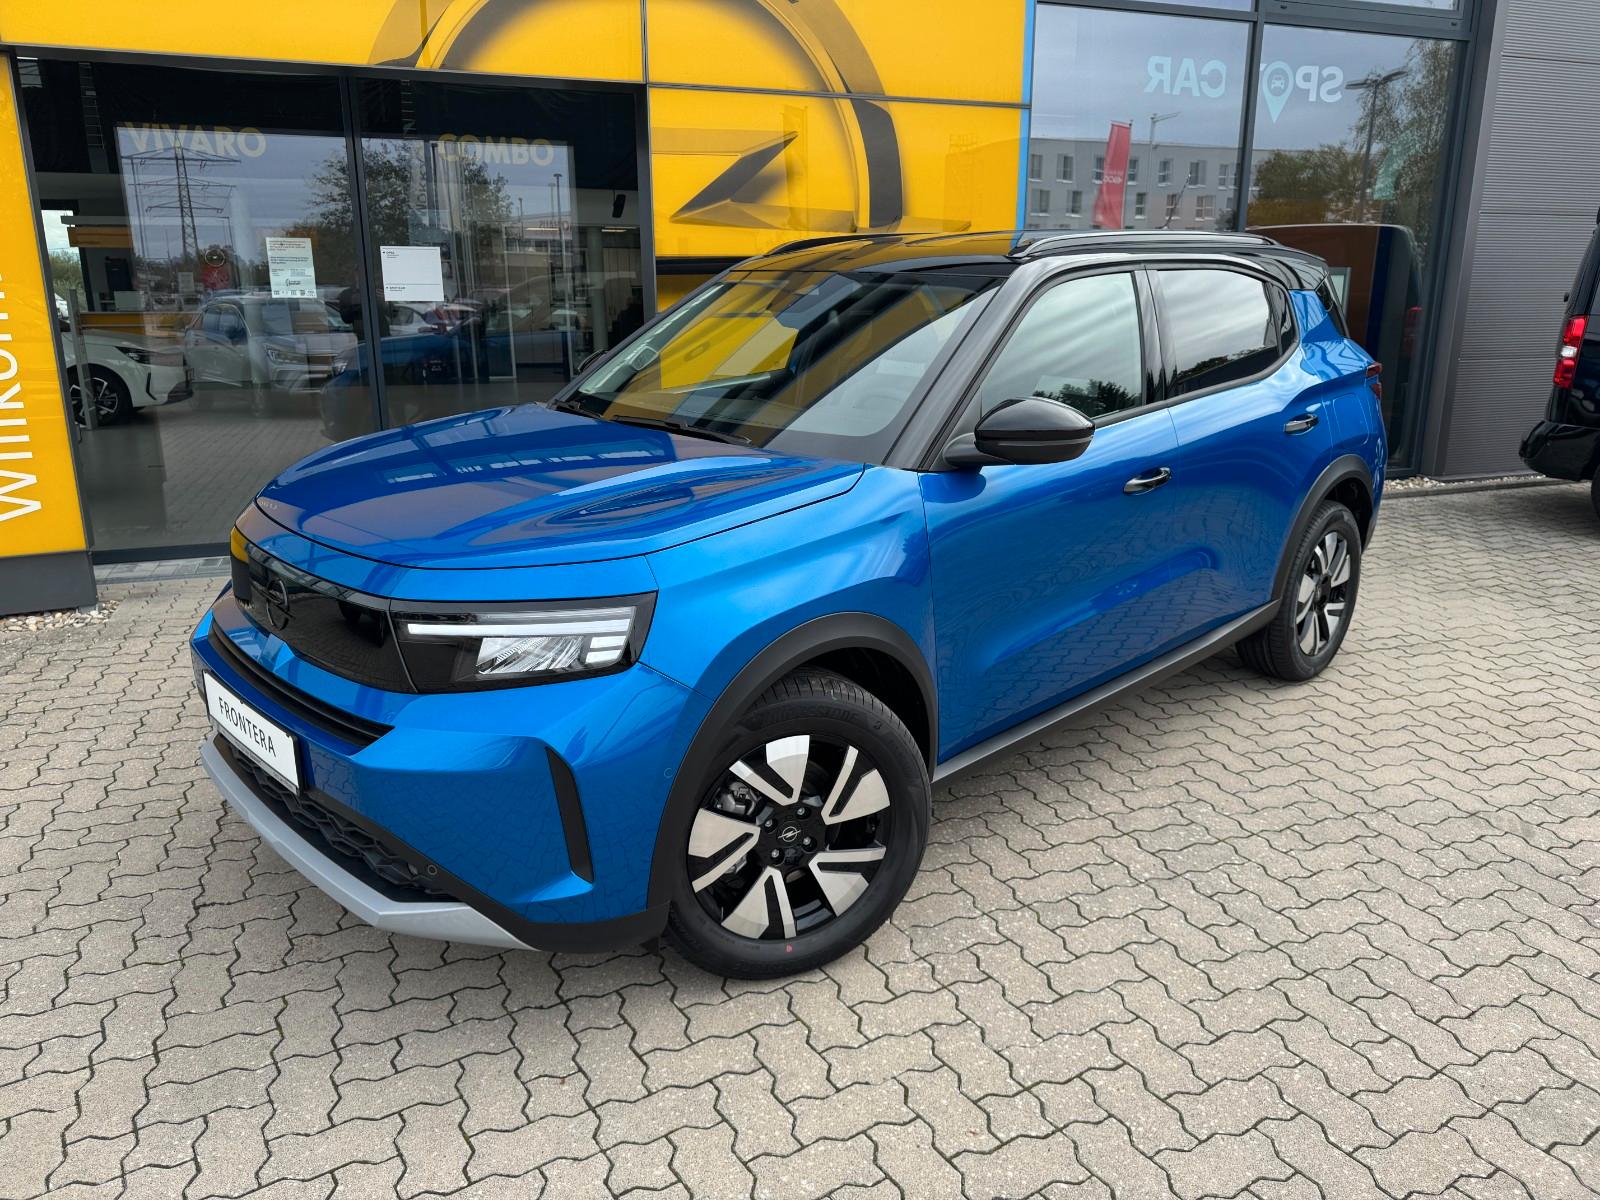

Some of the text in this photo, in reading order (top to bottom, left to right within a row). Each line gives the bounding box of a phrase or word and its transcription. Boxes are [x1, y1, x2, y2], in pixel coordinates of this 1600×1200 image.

[124, 122, 267, 159] VIVARO
[438, 133, 555, 166] COMBO
[218, 697, 277, 758] FRONTERA
